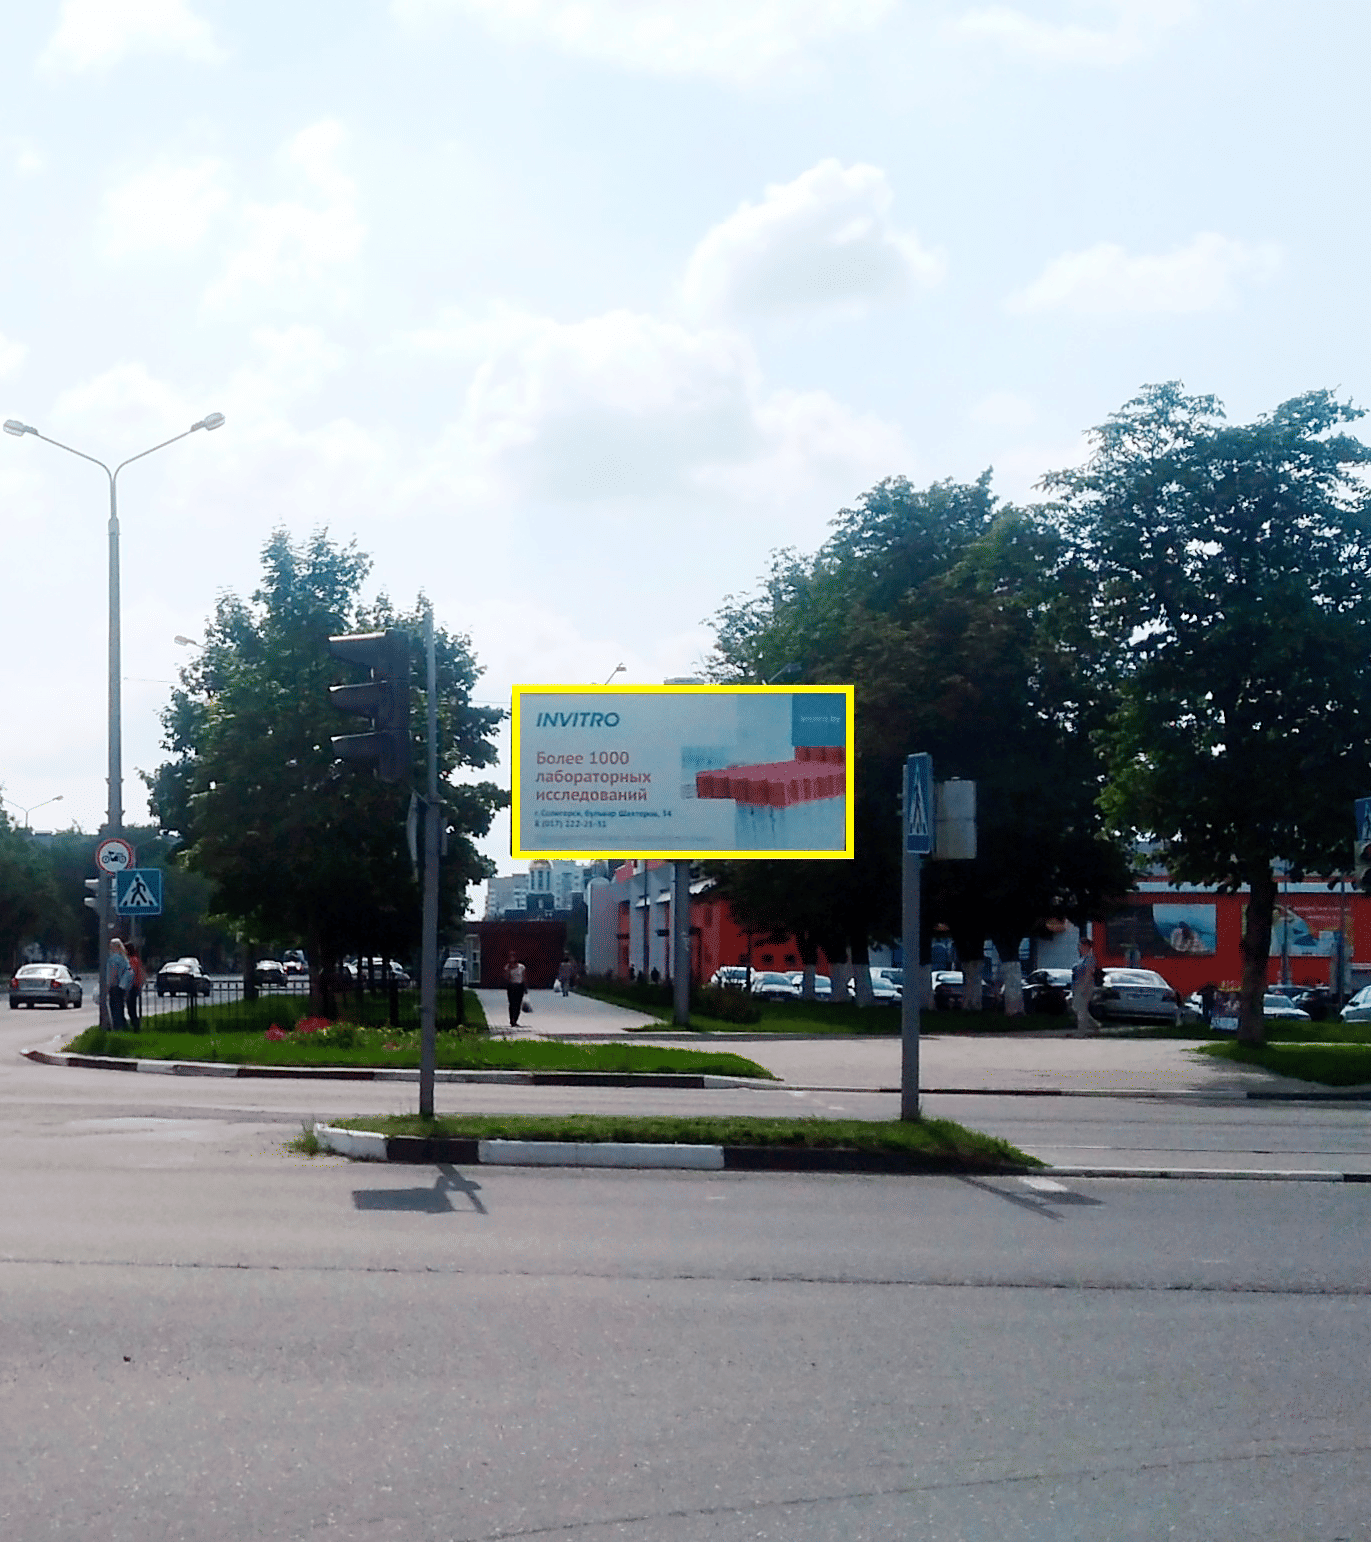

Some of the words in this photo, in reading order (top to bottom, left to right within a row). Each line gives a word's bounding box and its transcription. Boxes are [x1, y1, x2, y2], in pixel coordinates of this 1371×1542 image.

[536, 712, 620, 727] INVITRO
[536, 751, 584, 765] Более
[589, 751, 630, 765] 1000
[535, 769, 652, 786] лабораторных
[535, 788, 648, 802] исследований
